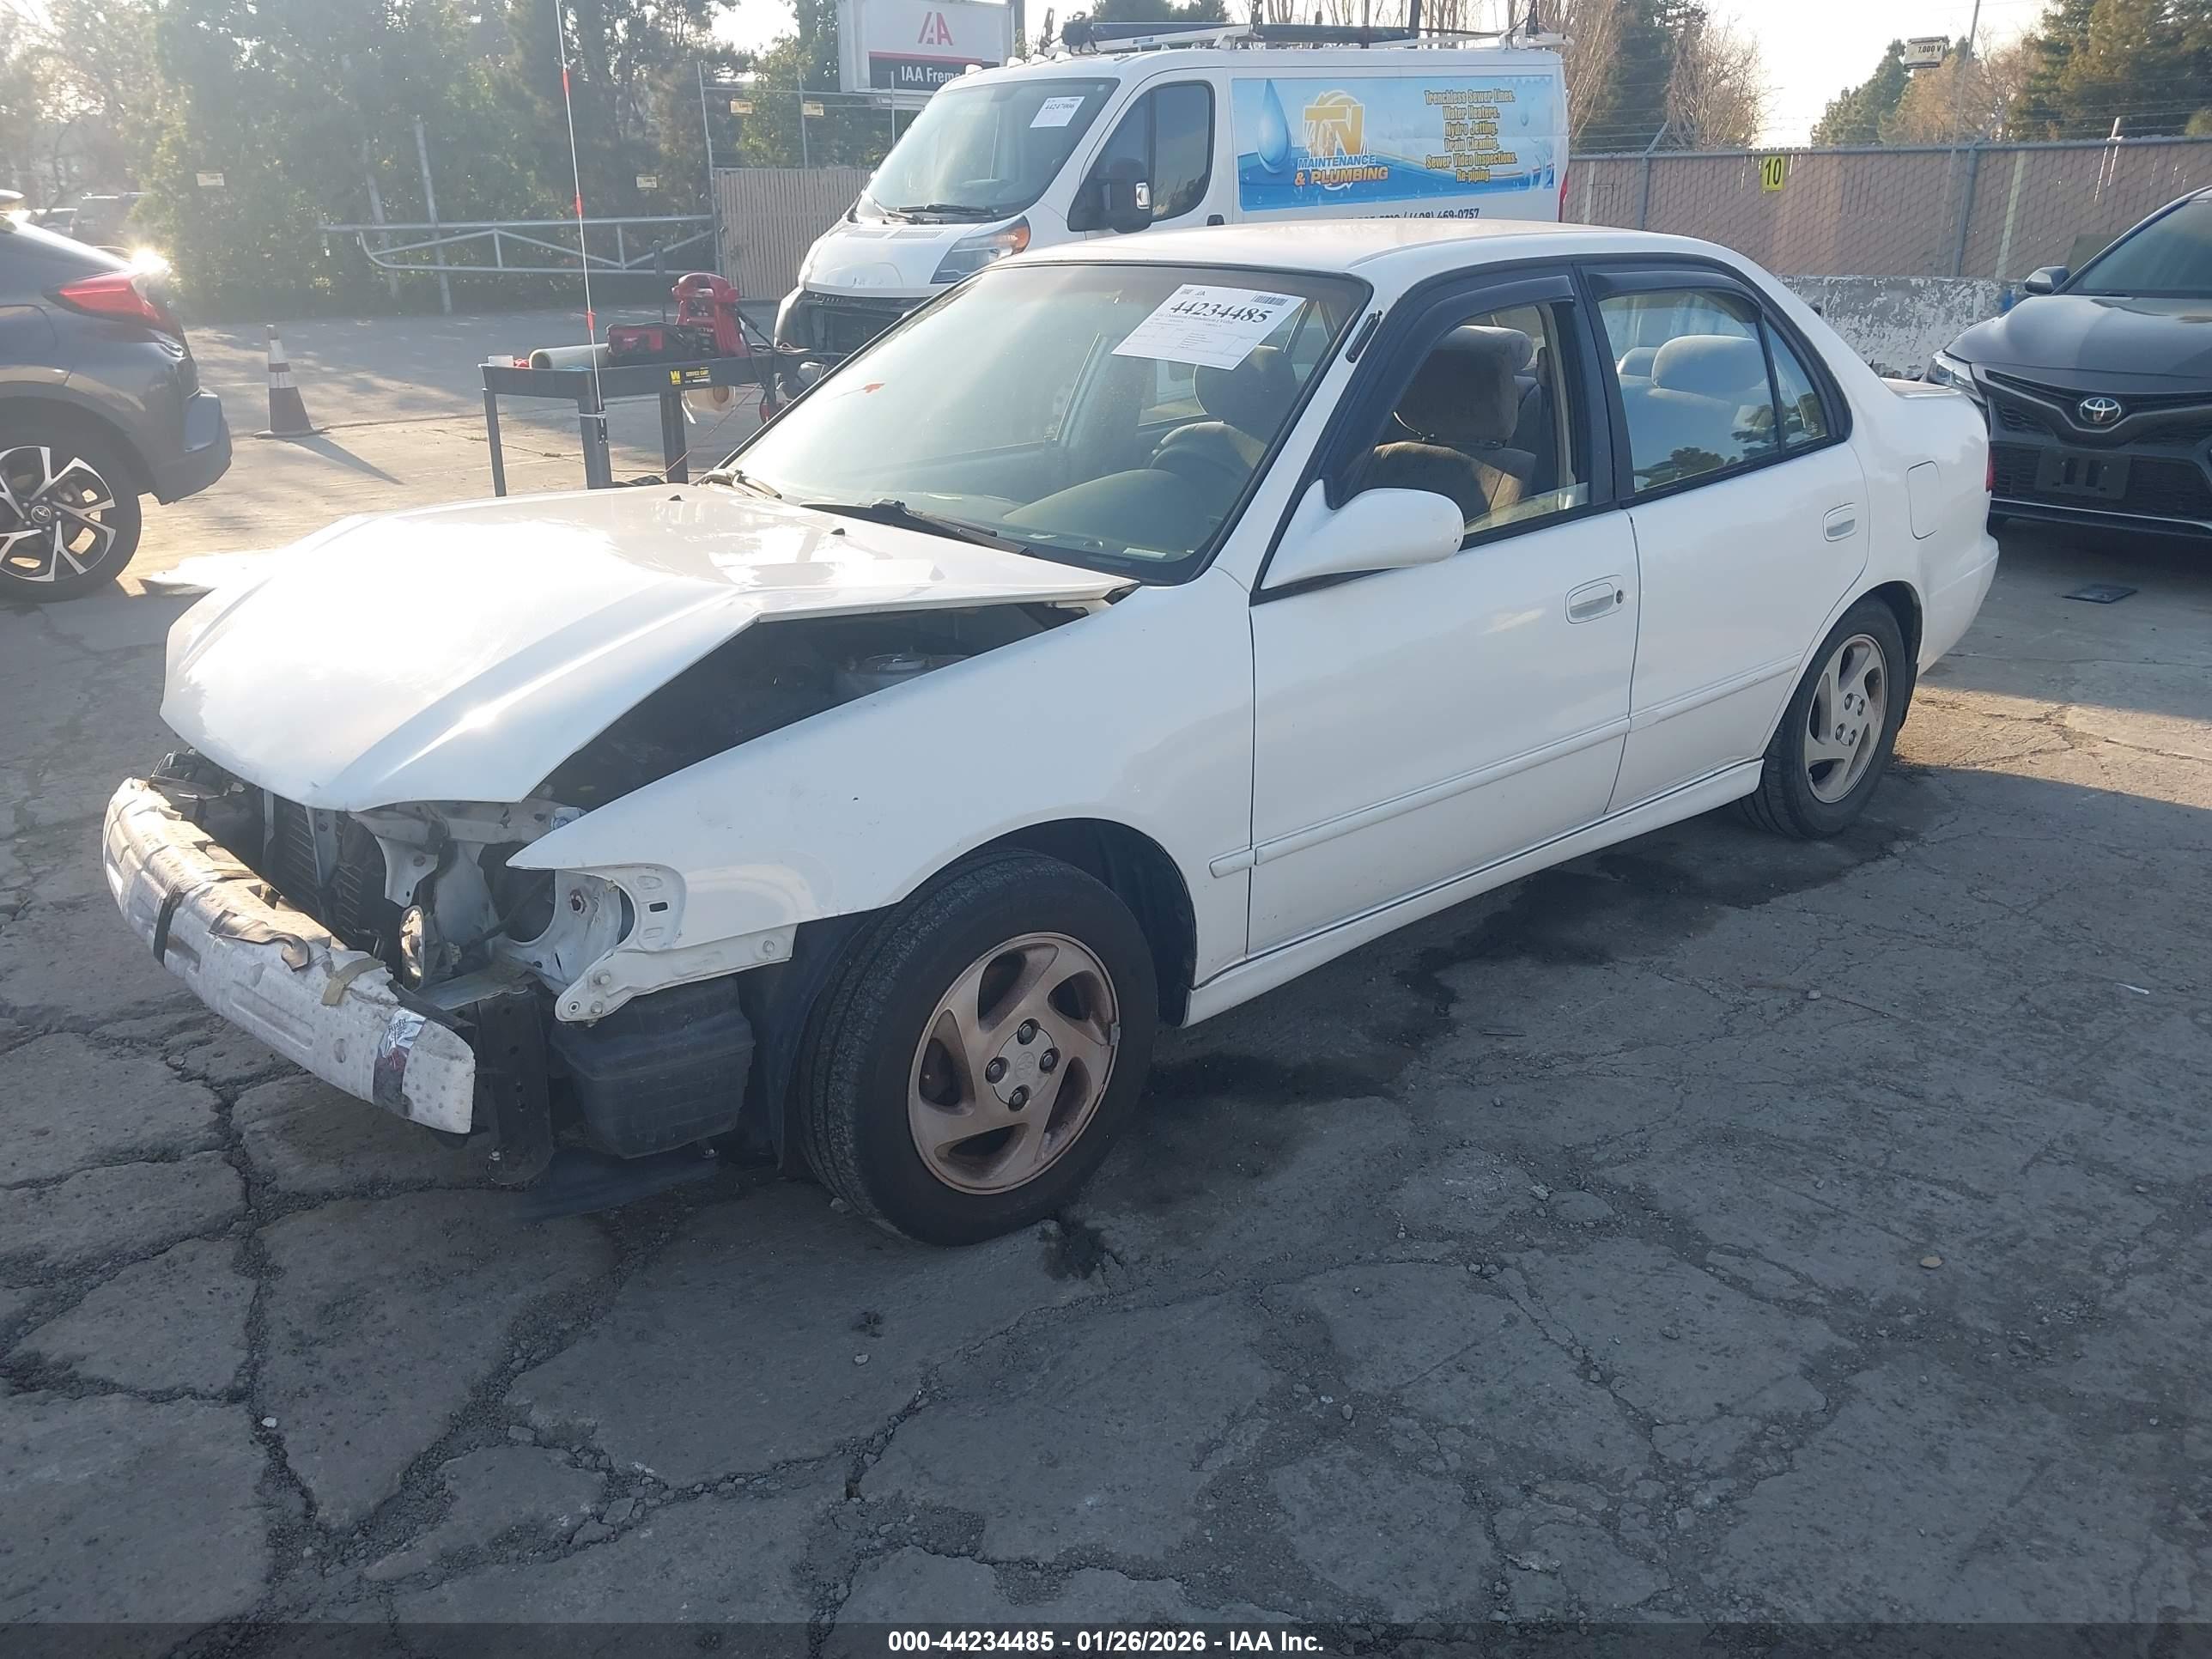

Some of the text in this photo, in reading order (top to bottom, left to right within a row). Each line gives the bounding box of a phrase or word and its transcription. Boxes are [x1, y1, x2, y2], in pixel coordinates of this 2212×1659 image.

[901, 65, 924, 82] IAA
[1425, 88, 1516, 105] Trenchless Sewer Lines.
[1443, 105, 1500, 120] Water Heaters.
[1445, 121, 1498, 137] Hydro Jetting.
[1444, 137, 1500, 152] Drain Cleaning.
[1297, 155, 1376, 169] MAINTENANCE
[1426, 151, 1517, 169] Sewer Video Inspections.
[1294, 166, 1389, 186] & PLUMBING
[1456, 167, 1490, 184] Re-piping
[1765, 158, 1782, 185] 10
[1170, 301, 1273, 323] 44234485
